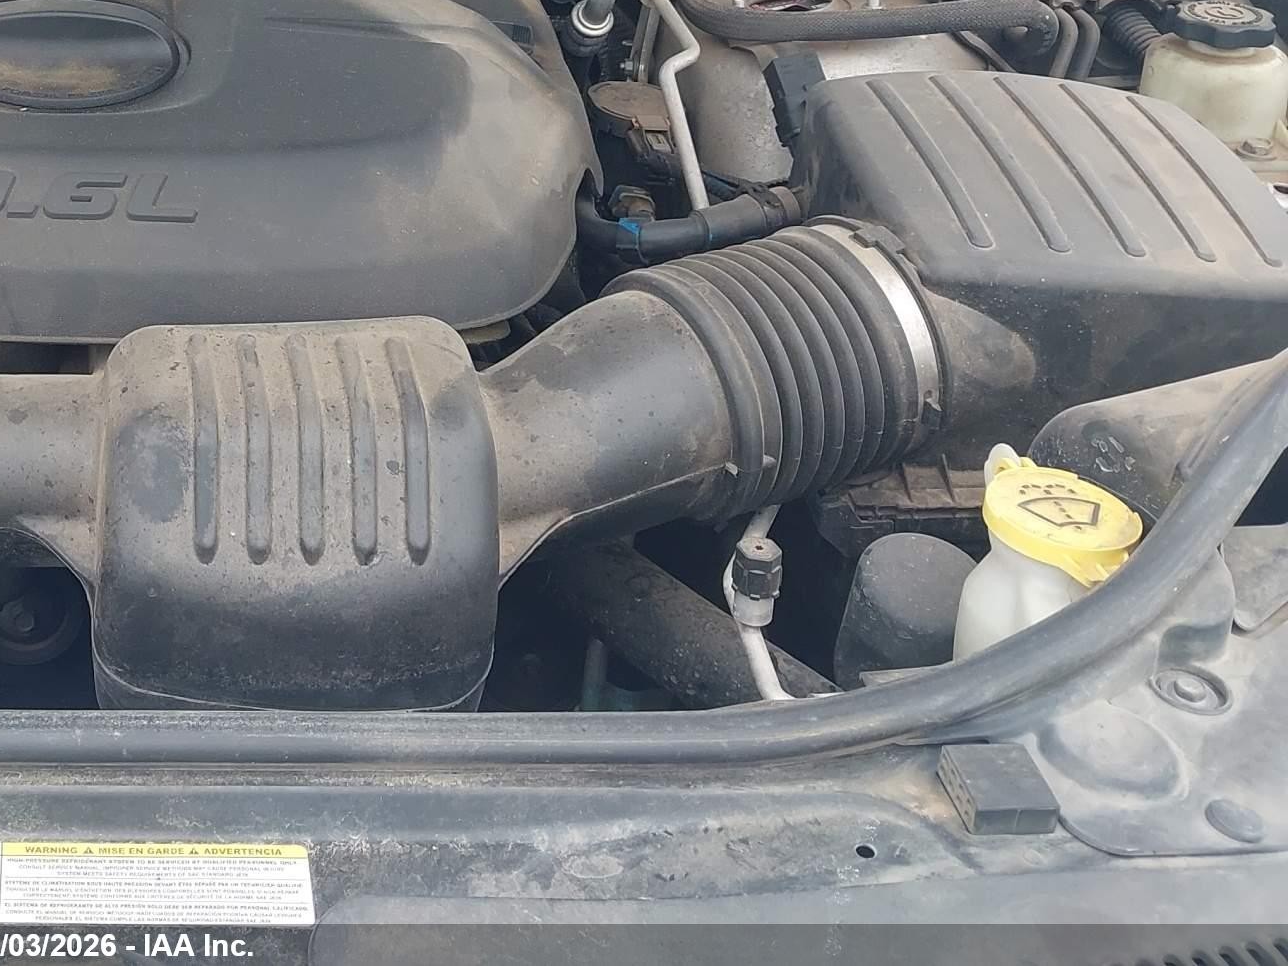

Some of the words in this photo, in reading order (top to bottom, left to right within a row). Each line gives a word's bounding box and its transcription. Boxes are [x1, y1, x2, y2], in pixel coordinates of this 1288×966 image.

[25, 846, 78, 854] WARNING
[99, 847, 125, 855] MISE
[129, 847, 144, 855] EN
[147, 847, 185, 855] GARDE
[204, 848, 282, 856] ADVERTENCIA
